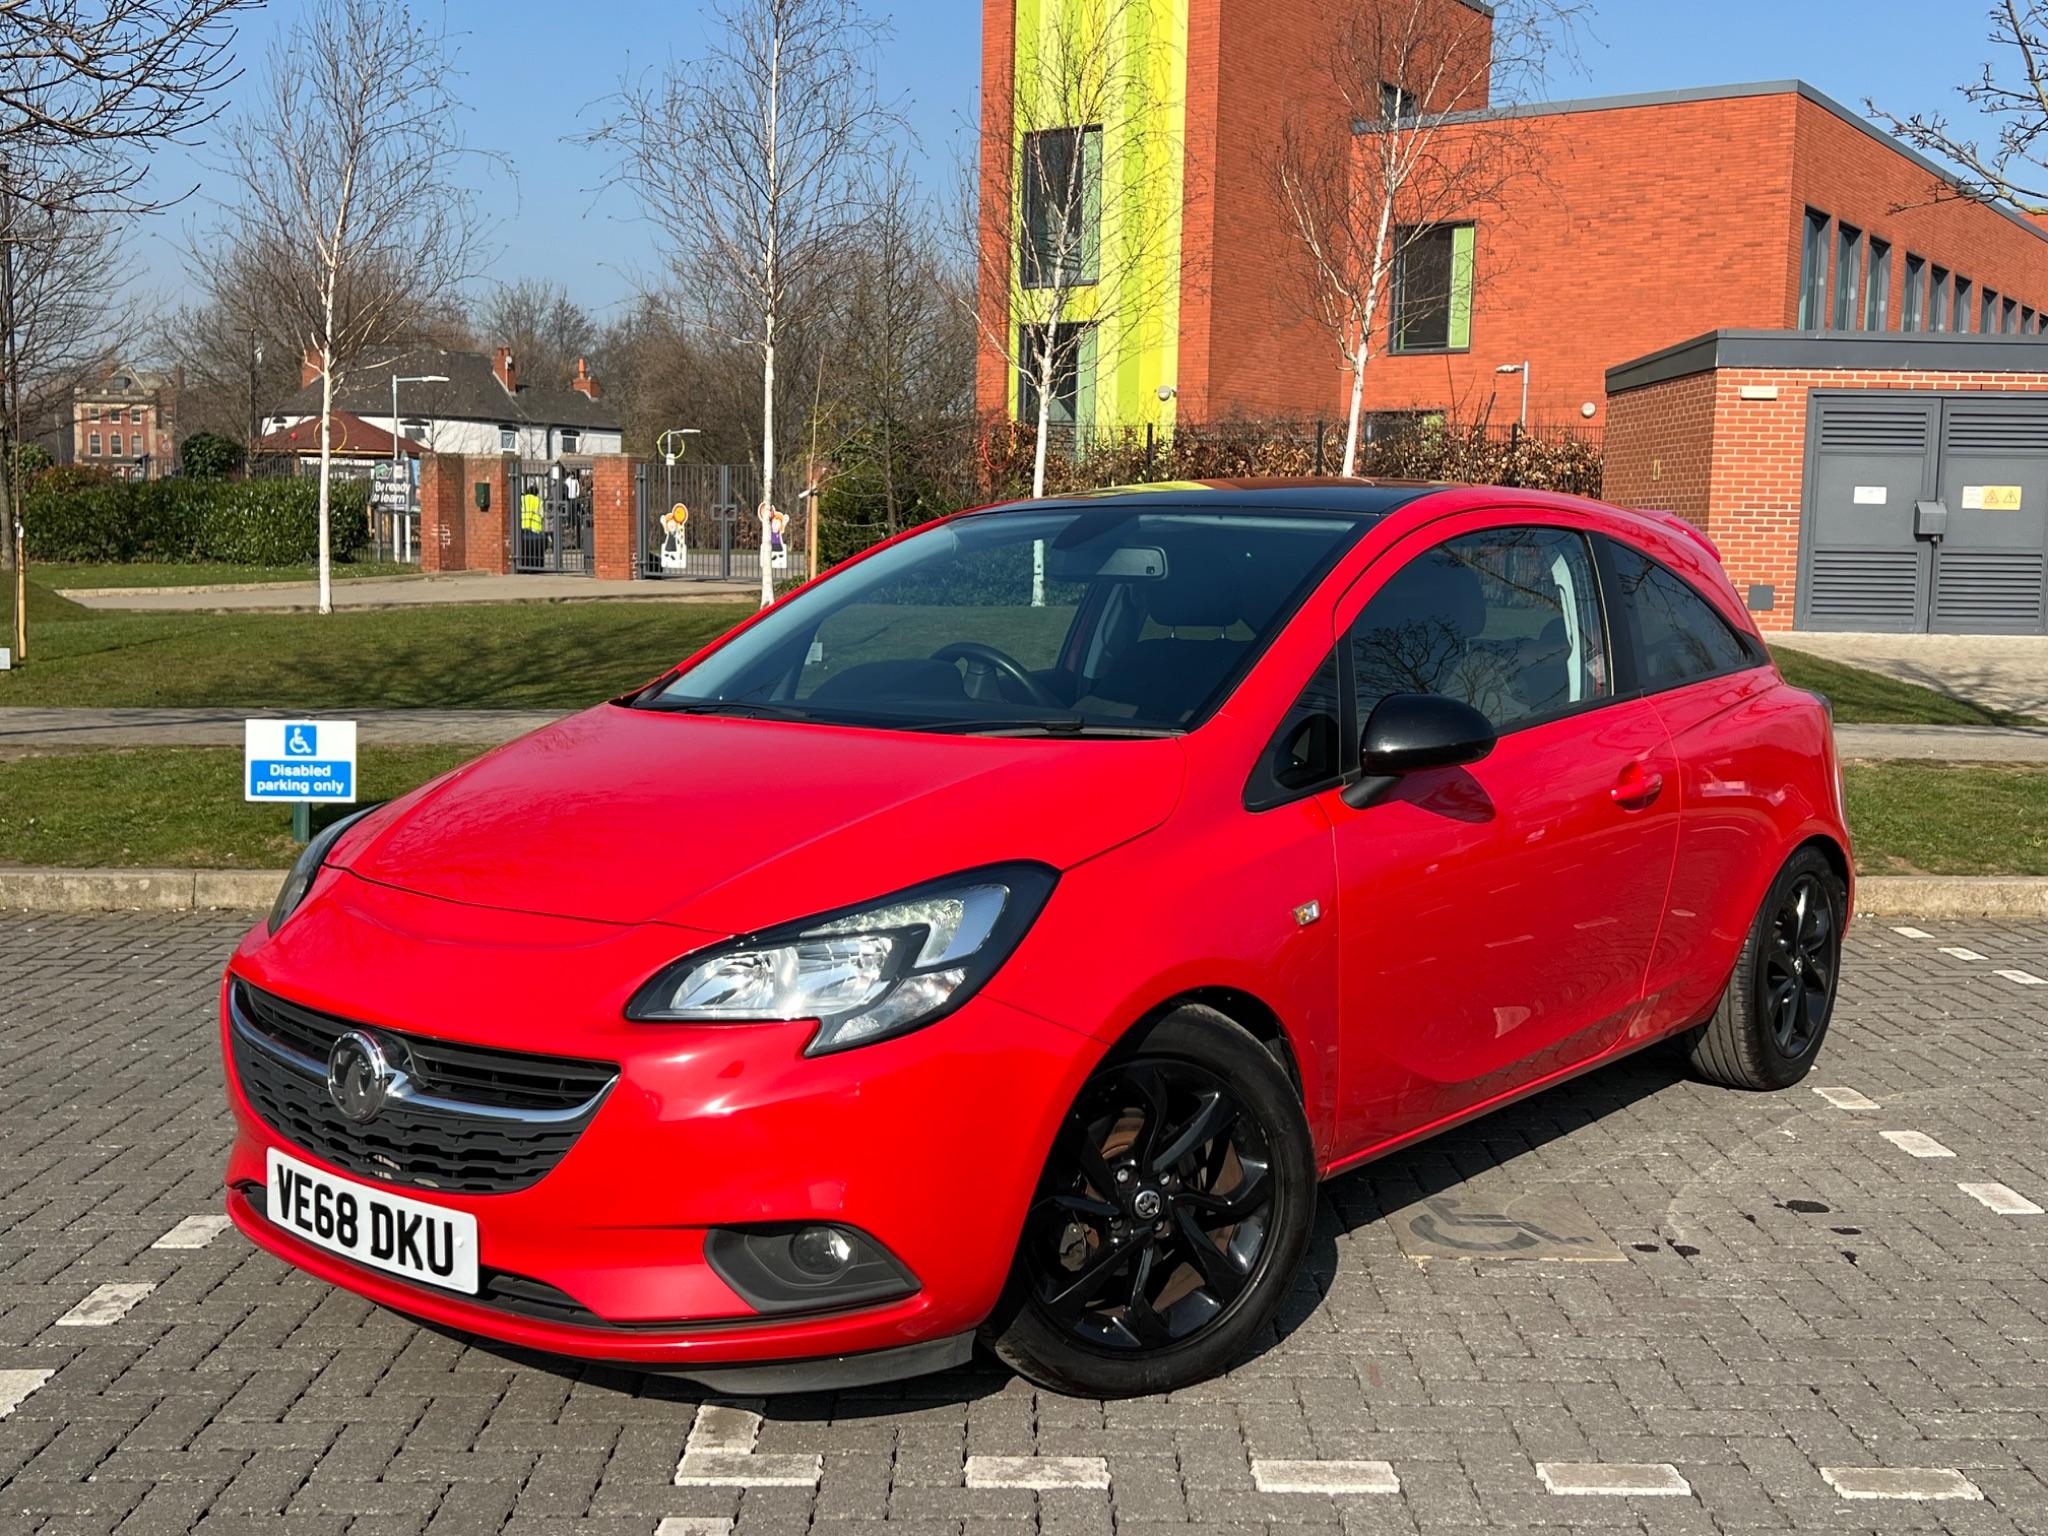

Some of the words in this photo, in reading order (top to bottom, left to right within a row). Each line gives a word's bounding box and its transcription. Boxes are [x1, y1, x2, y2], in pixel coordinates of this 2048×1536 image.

[385, 481, 411, 494] ready
[380, 492, 405, 503] learn
[269, 764, 332, 777] Disabled
[256, 779, 310, 795] parking
[313, 780, 345, 795] only
[276, 1163, 359, 1249] VE68
[369, 1200, 455, 1277] DKU
